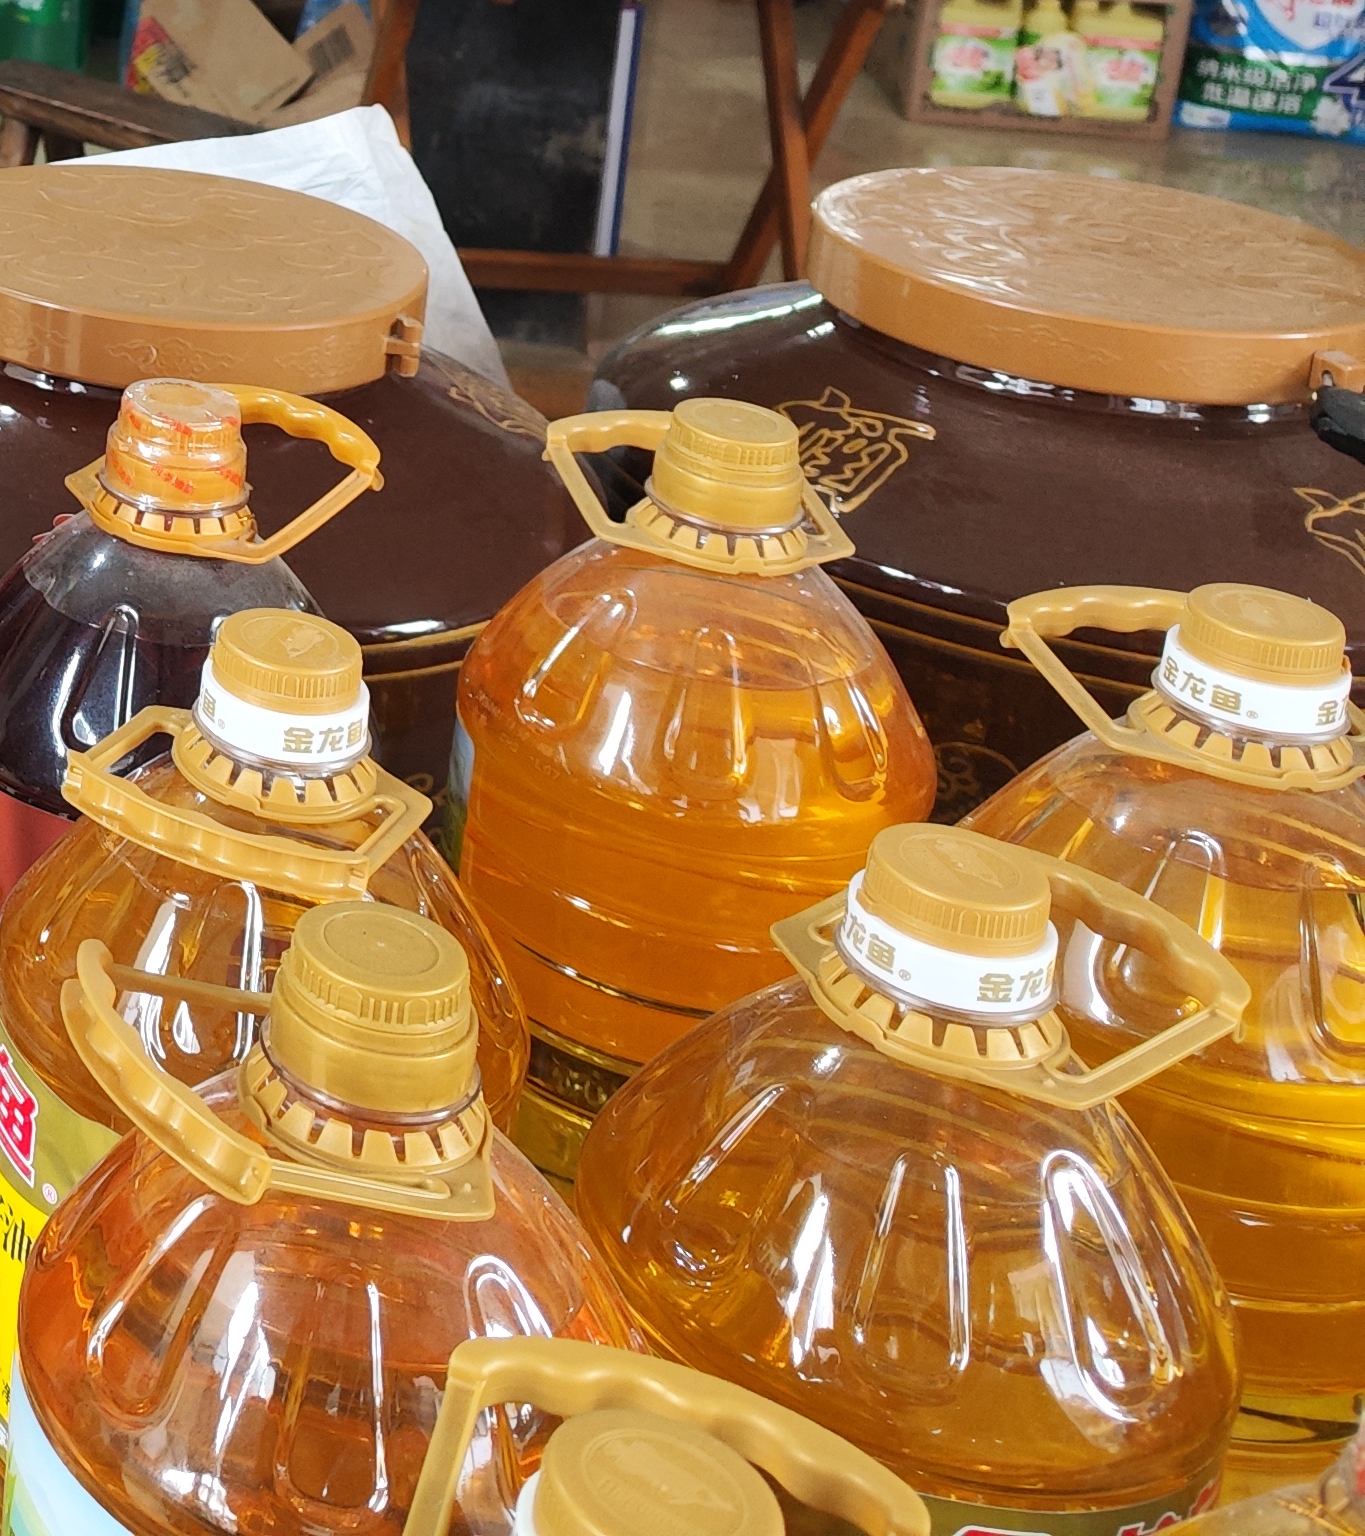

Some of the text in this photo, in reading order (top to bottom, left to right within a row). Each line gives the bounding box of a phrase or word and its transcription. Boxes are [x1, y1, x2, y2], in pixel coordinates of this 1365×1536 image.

[1162, 654, 1243, 717] 金龙鱼
[283, 724, 367, 754] 金龙鱼
[839, 914, 896, 976] 龙鱼
